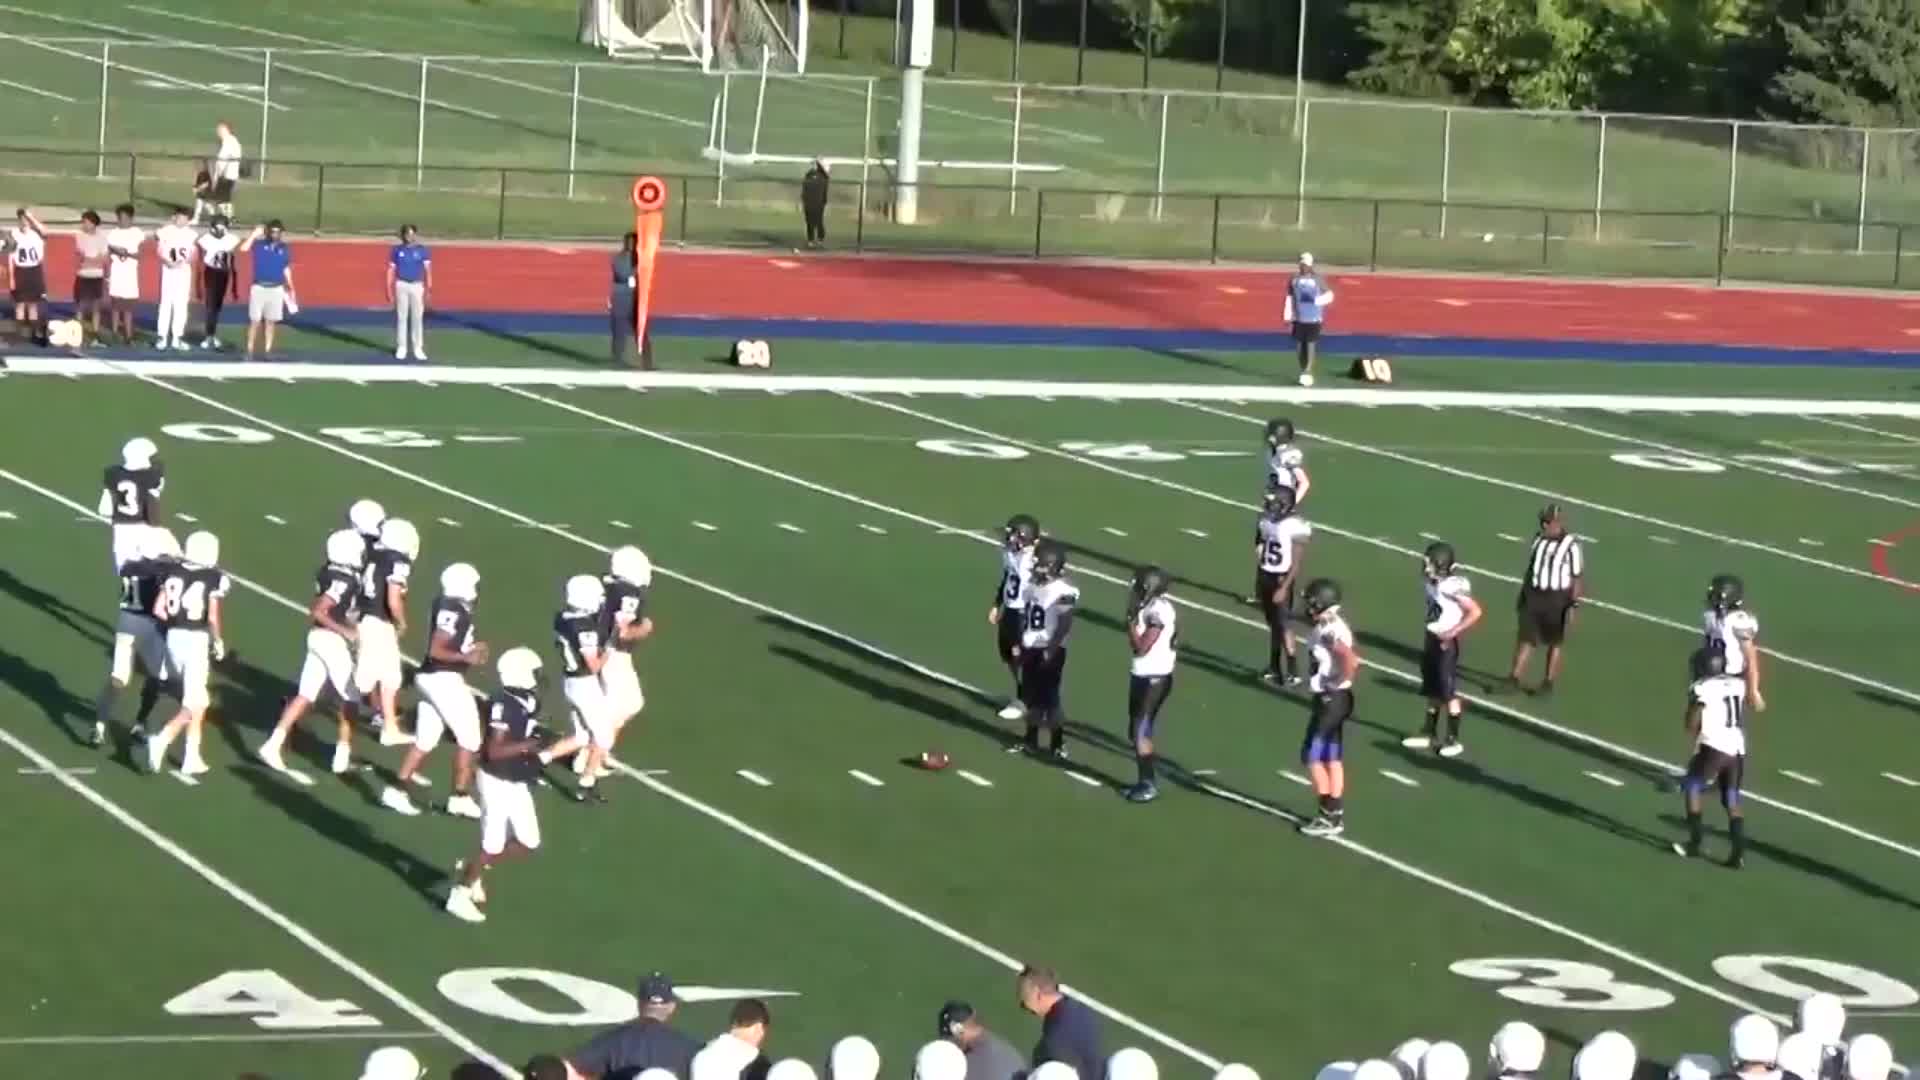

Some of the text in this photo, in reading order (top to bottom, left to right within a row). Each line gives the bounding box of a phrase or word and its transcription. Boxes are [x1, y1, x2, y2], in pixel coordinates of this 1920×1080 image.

[1362, 359, 1392, 381] 10
[117, 480, 139, 516] 3
[164, 576, 206, 621] 84
[1722, 695, 1742, 729] 11
